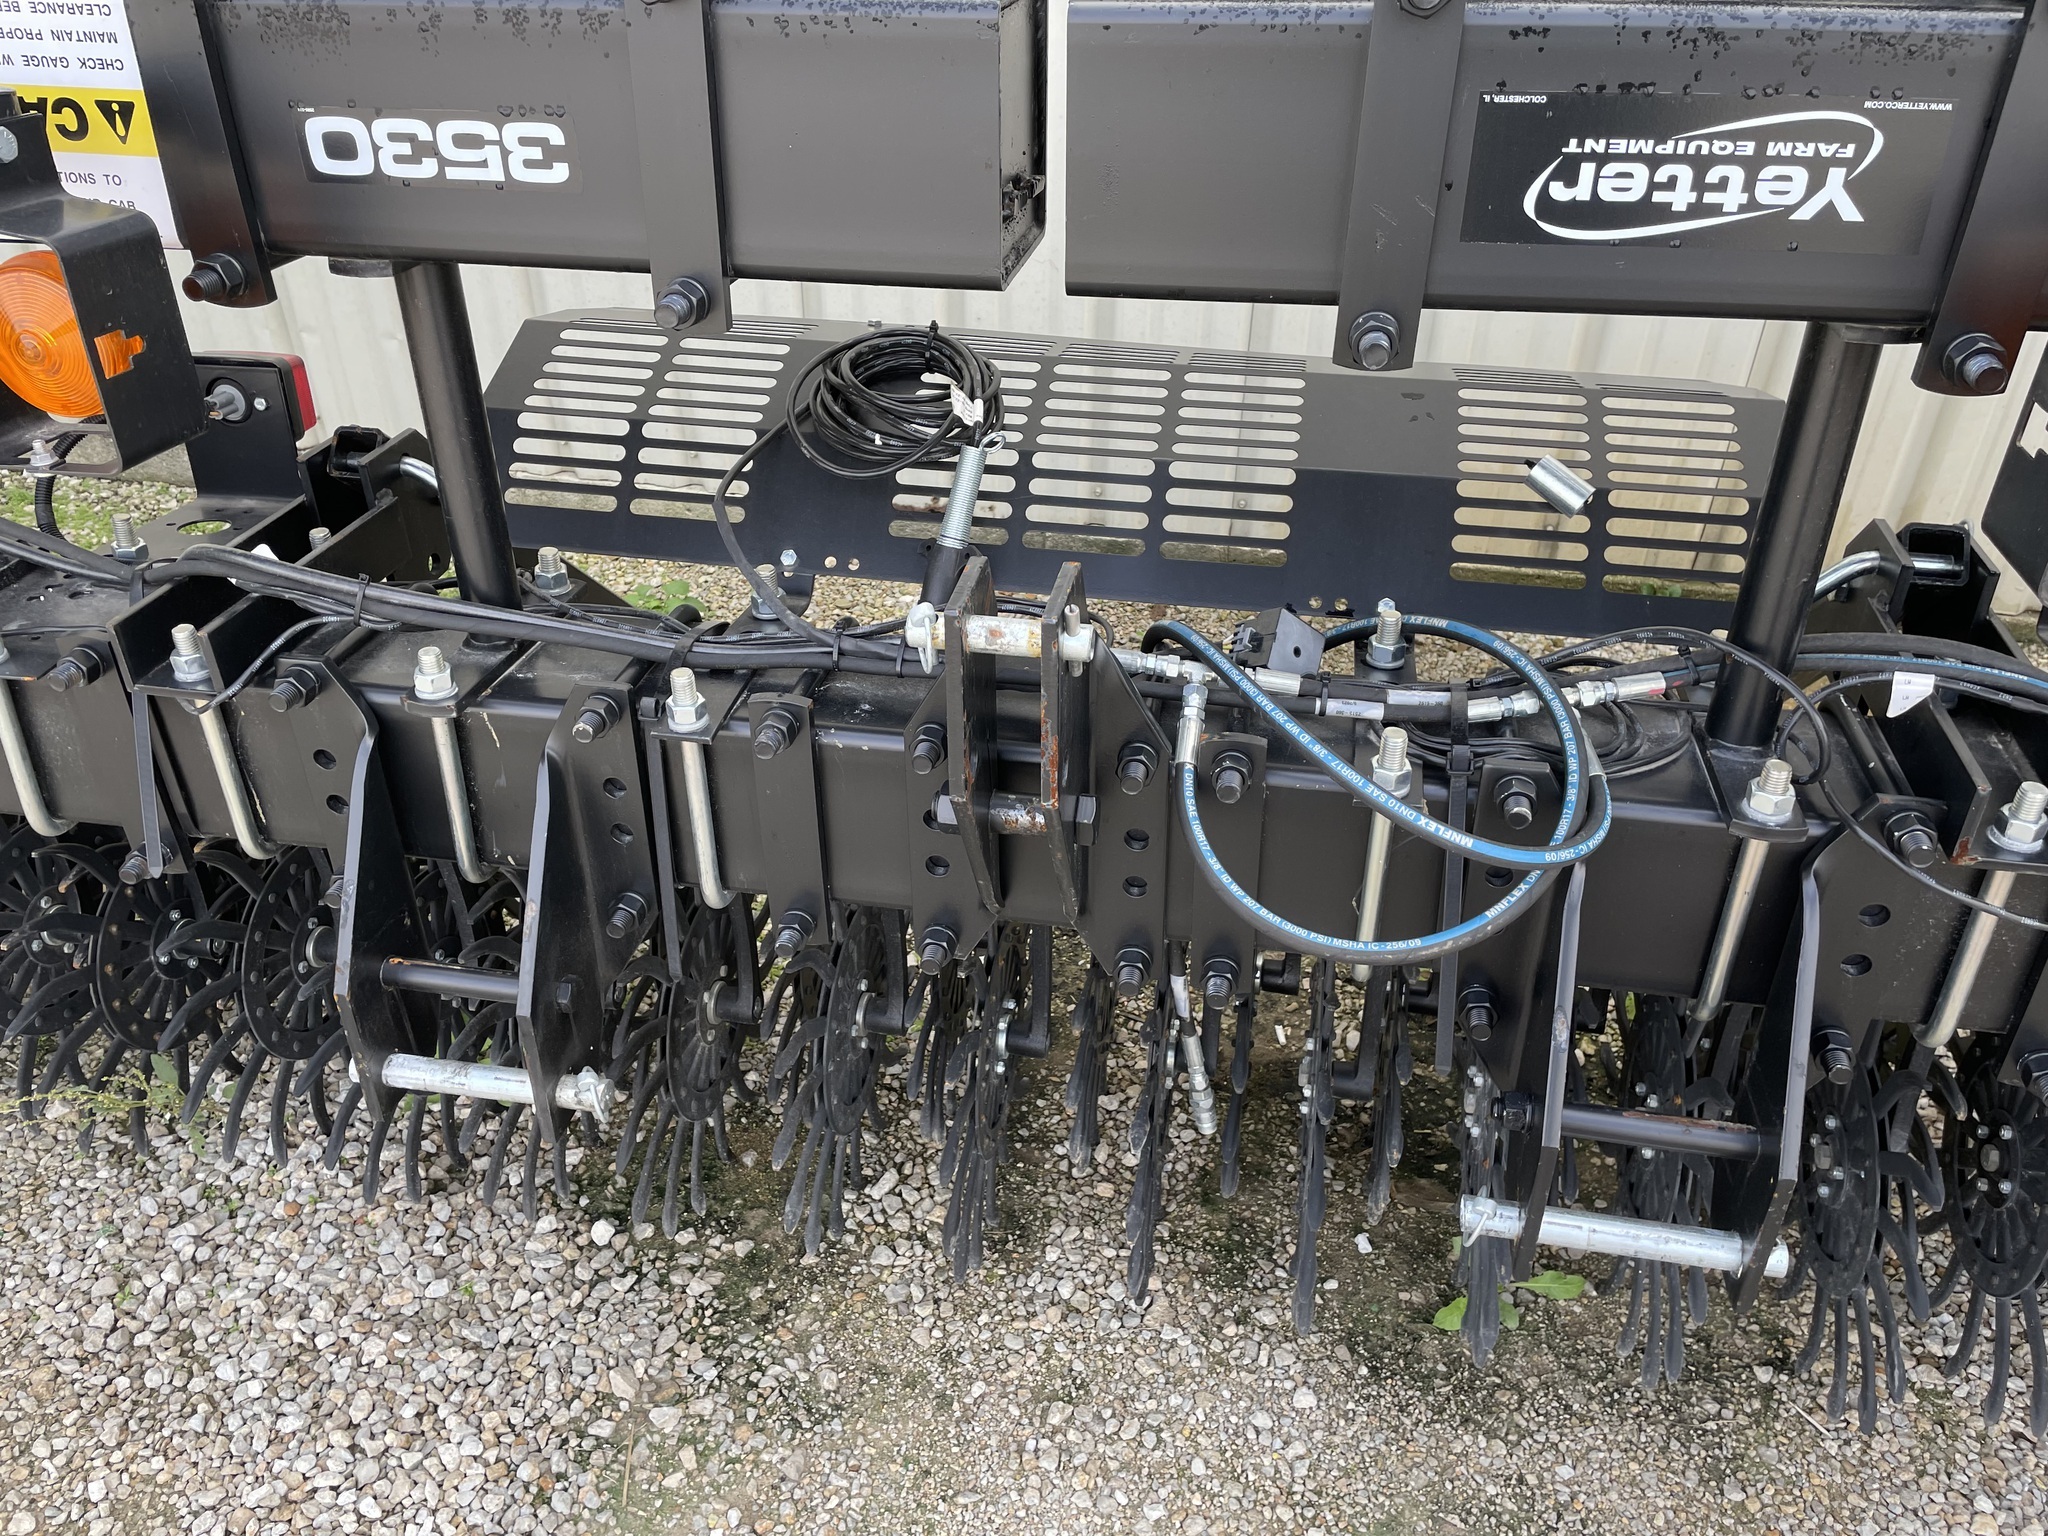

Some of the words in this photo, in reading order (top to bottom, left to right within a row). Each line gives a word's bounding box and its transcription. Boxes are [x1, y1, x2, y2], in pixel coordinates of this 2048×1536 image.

[0, 0, 20, 12] BE
[30, 1, 111, 16] CLEARANCE
[51, 29, 118, 44] MAINTAIN
[0, 54, 15, 66] W
[21, 54, 70, 69] GAUGE
[77, 57, 124, 71] CHECK
[1494, 93, 1547, 104] COLCHESTER,
[1864, 100, 1953, 111] WWW.YETTERCO.COM
[304, 116, 570, 184] 3530
[1561, 137, 1756, 157] EQUIPMENT
[1766, 141, 1857, 159] FARM
[103, 174, 122, 186] TO
[1546, 161, 1864, 223] Yetter
[1409, 615, 1449, 628] MNFLEX
[1240, 679, 1259, 698] (3000
[1255, 694, 1273, 711] BAR
[1550, 700, 1569, 720] (3000
[1271, 710, 1288, 723] 207
[1285, 722, 1300, 735] WP
[1560, 720, 1573, 739] BAR
[1300, 734, 1311, 743] ID
[1566, 741, 1576, 755] 207
[1568, 758, 1578, 772] WP
[1331, 760, 1364, 786] 100R17
[1568, 773, 1577, 783] ID
[1184, 773, 1194, 797] DN10
[1365, 784, 1388, 803] SAE
[1187, 798, 1198, 818] SAE
[1388, 799, 1416, 820] DN10
[1553, 809, 1572, 839] 100R17
[1192, 820, 1210, 850] 100R17
[1417, 816, 1474, 848] MNFLEX
[1221, 873, 1232, 883] ID
[1230, 882, 1244, 896] WP
[1243, 896, 1260, 909] 207
[1484, 882, 1529, 919] MNFLEX
[1260, 908, 1281, 924] BAR
[1282, 921, 1308, 937] (3000
